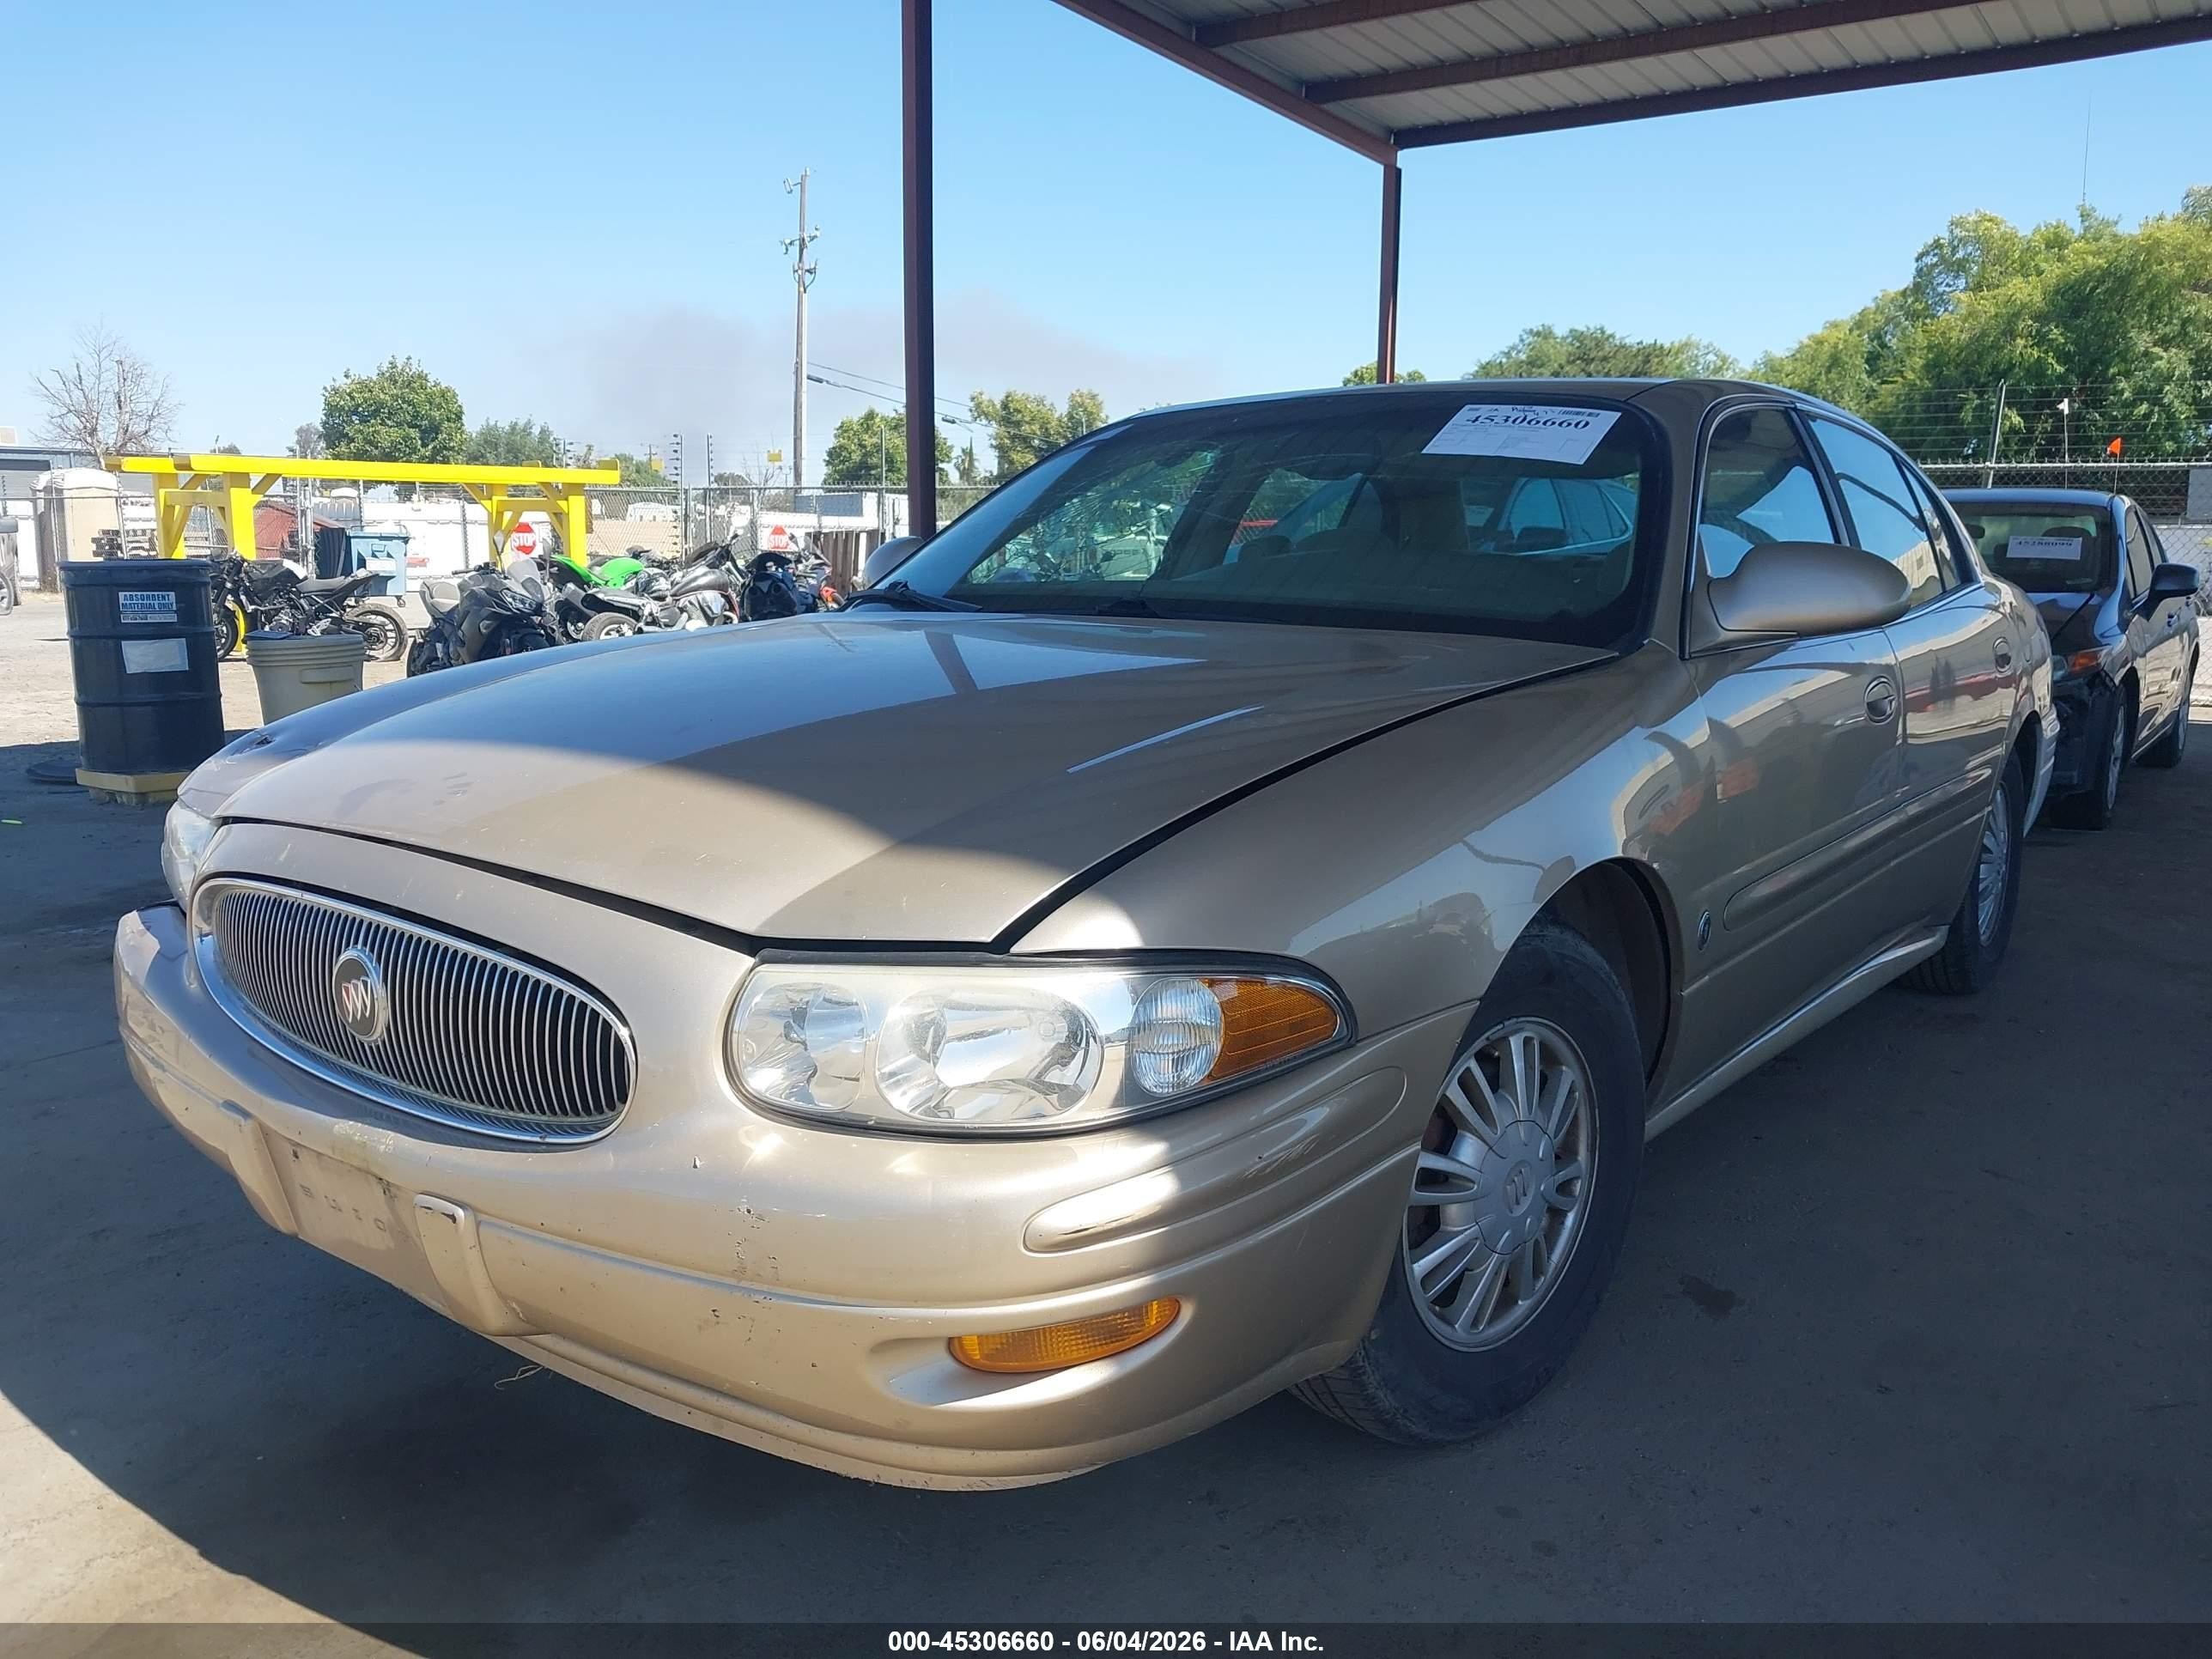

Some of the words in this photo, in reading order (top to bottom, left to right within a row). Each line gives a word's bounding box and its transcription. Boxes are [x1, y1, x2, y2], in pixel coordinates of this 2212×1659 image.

[1466, 414, 1590, 429] 45306660
[514, 532, 536, 546] STOP
[123, 593, 171, 602] ABSORBENT
